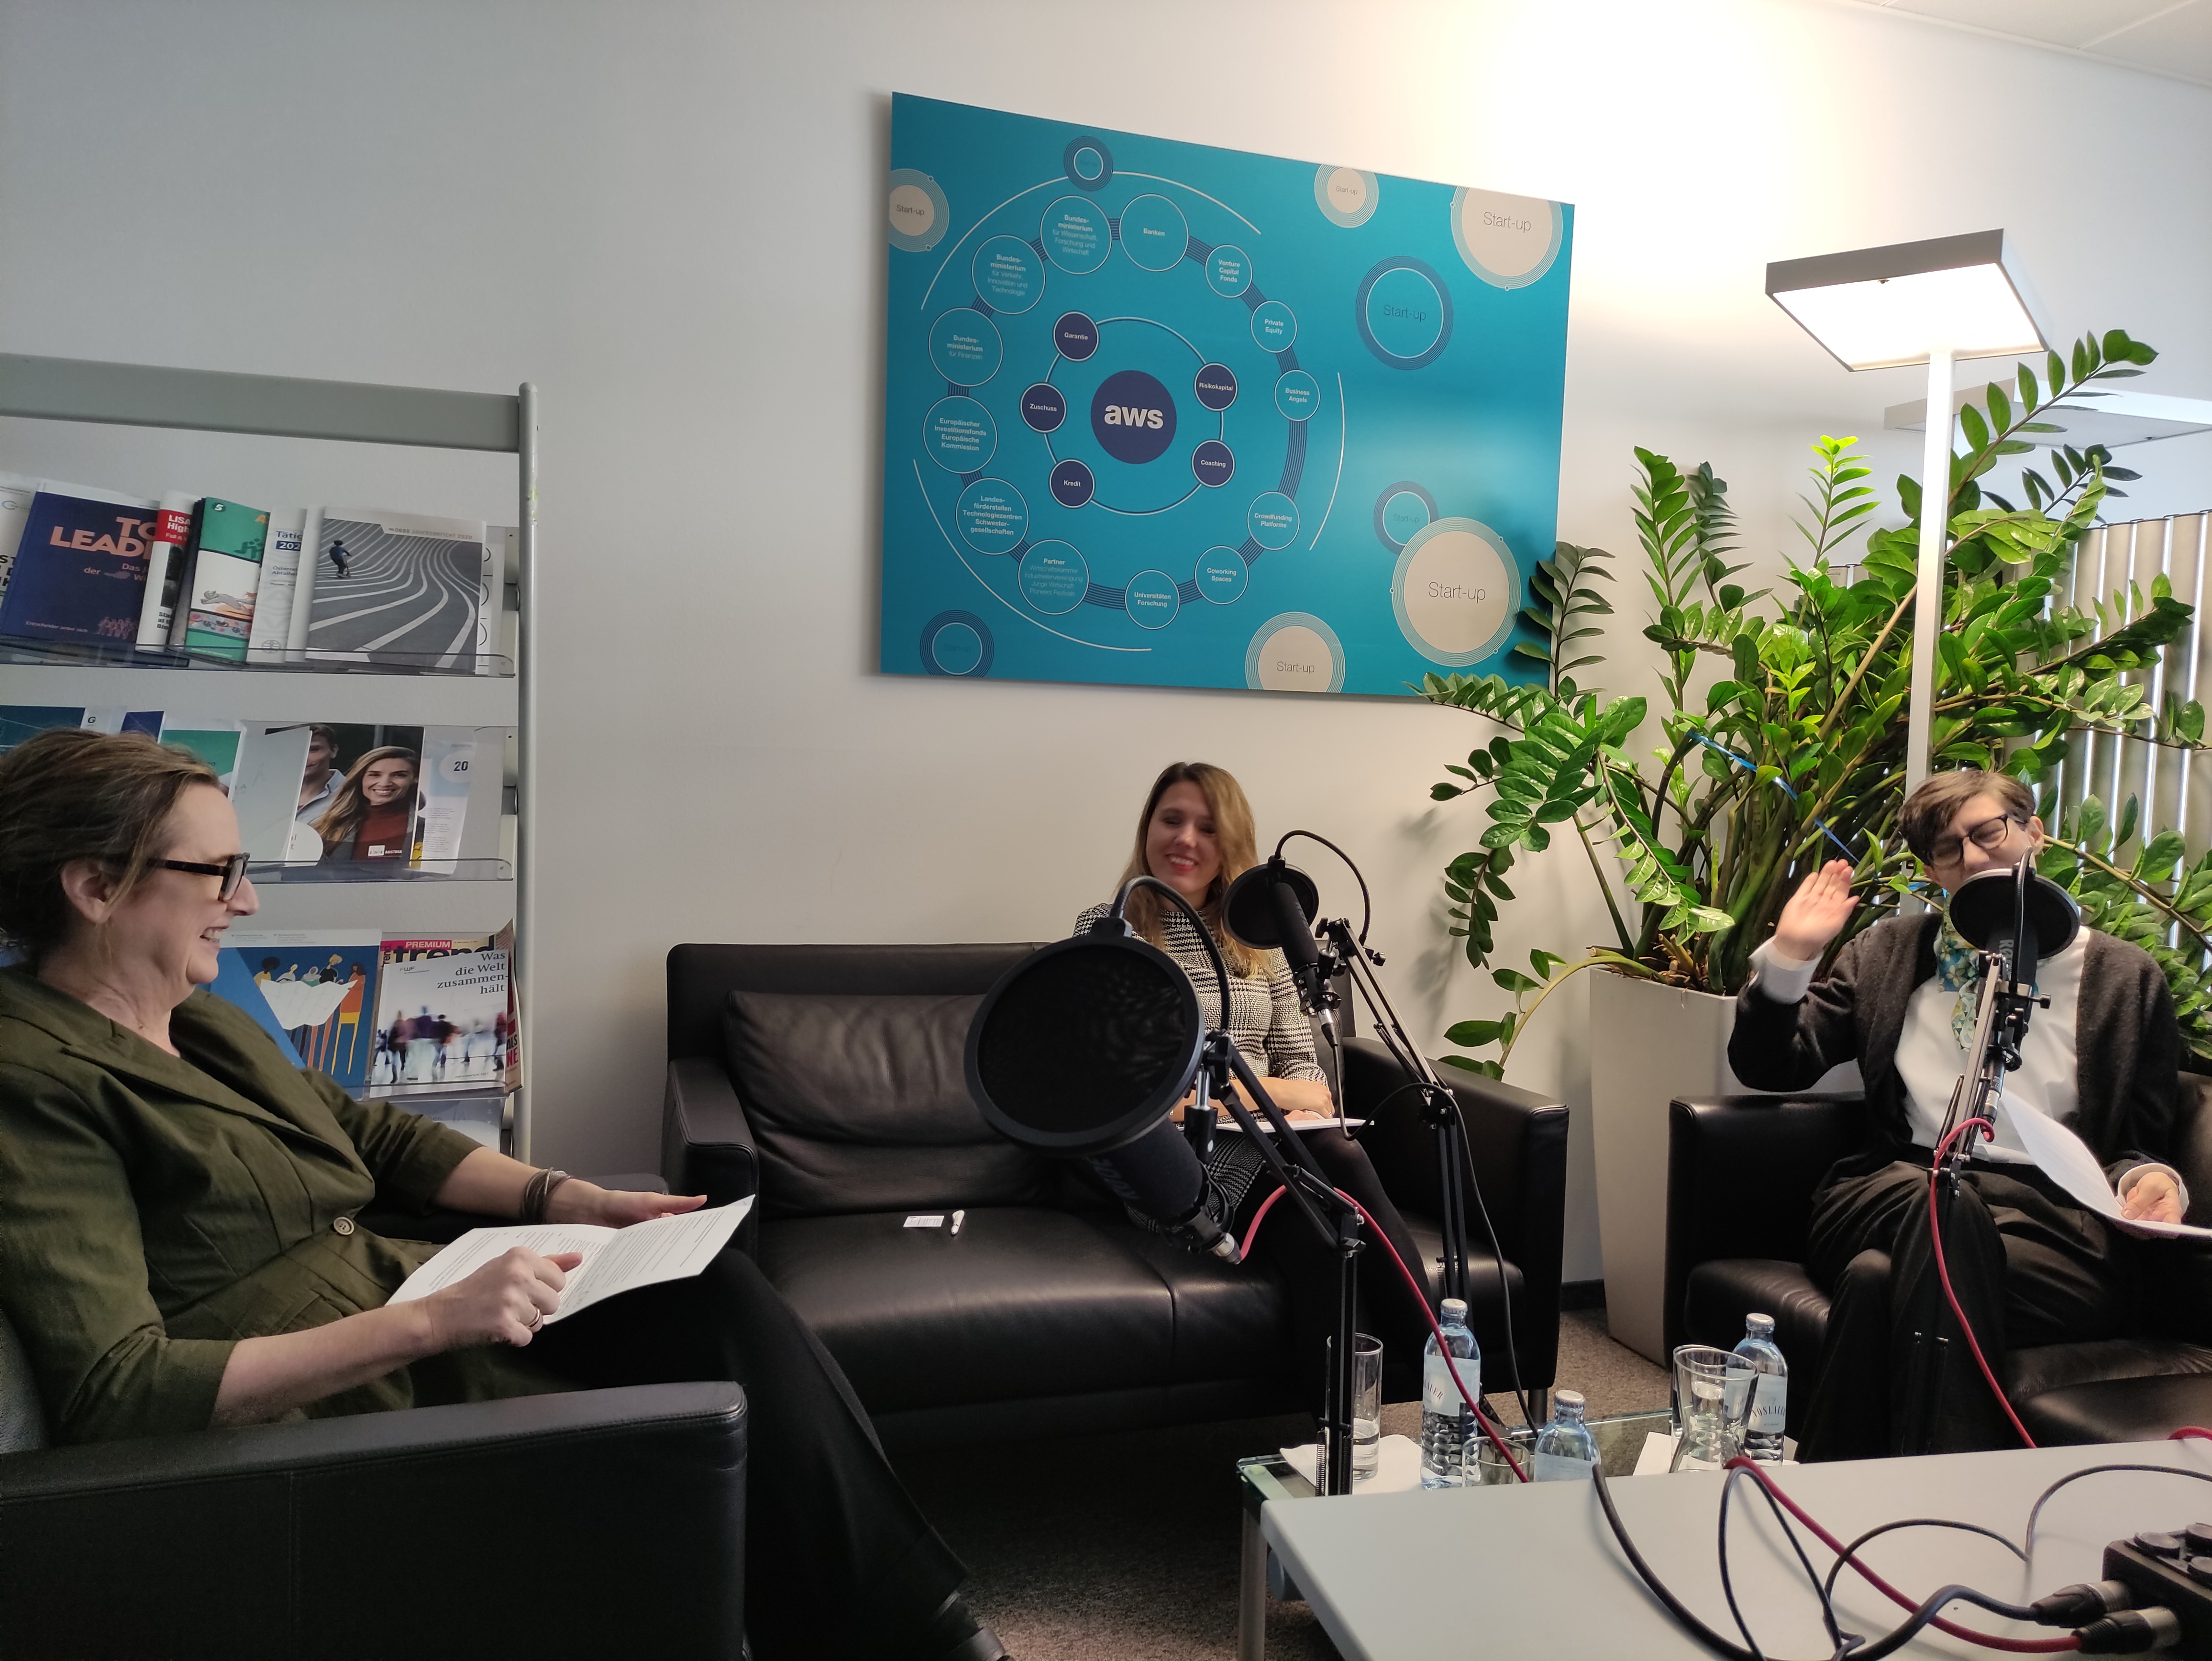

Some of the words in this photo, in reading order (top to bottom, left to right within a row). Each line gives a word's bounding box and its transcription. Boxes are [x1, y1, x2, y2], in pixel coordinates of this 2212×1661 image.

[1335, 185, 1358, 195] Start-up
[896, 204, 925, 216] Start-up
[1064, 214, 1089, 223] Bundes-
[1483, 211, 1531, 233] Start-up
[1058, 222, 1093, 232] ministerium
[1143, 228, 1165, 236] Banken
[1055, 237, 1083, 248] Forschung
[1062, 247, 1089, 255] Wirtschaft
[996, 254, 1022, 263] Bundes-
[1218, 259, 1240, 267] Venture
[990, 262, 1026, 272] ministerium
[1219, 267, 1239, 275] Capital
[987, 277, 1016, 286] Innovation
[992, 286, 1025, 296] Technologie
[1383, 305, 1427, 322] Start-up
[1265, 326, 1283, 335] Equity
[953, 335, 979, 343] Bundes-
[1064, 332, 1088, 340] Garantie
[947, 343, 983, 352] ministerium
[958, 352, 983, 360] Finanzen
[1199, 382, 1233, 392] Risikokapital
[1285, 388, 1310, 396] Business
[1029, 403, 1057, 411] Zuschuss
[1104, 405, 1163, 429] aws
[934, 425, 986, 436] Investitionsfonds
[941, 434, 979, 443] Europäische
[941, 442, 979, 451] Kommission
[1201, 460, 1226, 468] Coaching
[973, 503, 1012, 511] förderstellen
[962, 509, 1022, 520] Technologiezentren
[1254, 512, 1292, 522] Crowdfunding
[1393, 514, 1420, 524] Start-up
[970, 526, 1014, 535] gesellschaften
[84, 567, 101, 575] der
[122, 563, 140, 572] Das
[1207, 568, 1237, 576] Coworking
[1134, 592, 1171, 600] Universitäten
[1428, 581, 1486, 603] Start-up
[1137, 599, 1167, 608] Forschung
[1276, 662, 1315, 675] Start-up
[453, 761, 469, 771] 20
[480, 952, 506, 961] Was
[455, 967, 474, 976] die
[477, 963, 506, 973] Welt
[437, 974, 509, 989] zusammen-
[480, 984, 505, 994] hält
